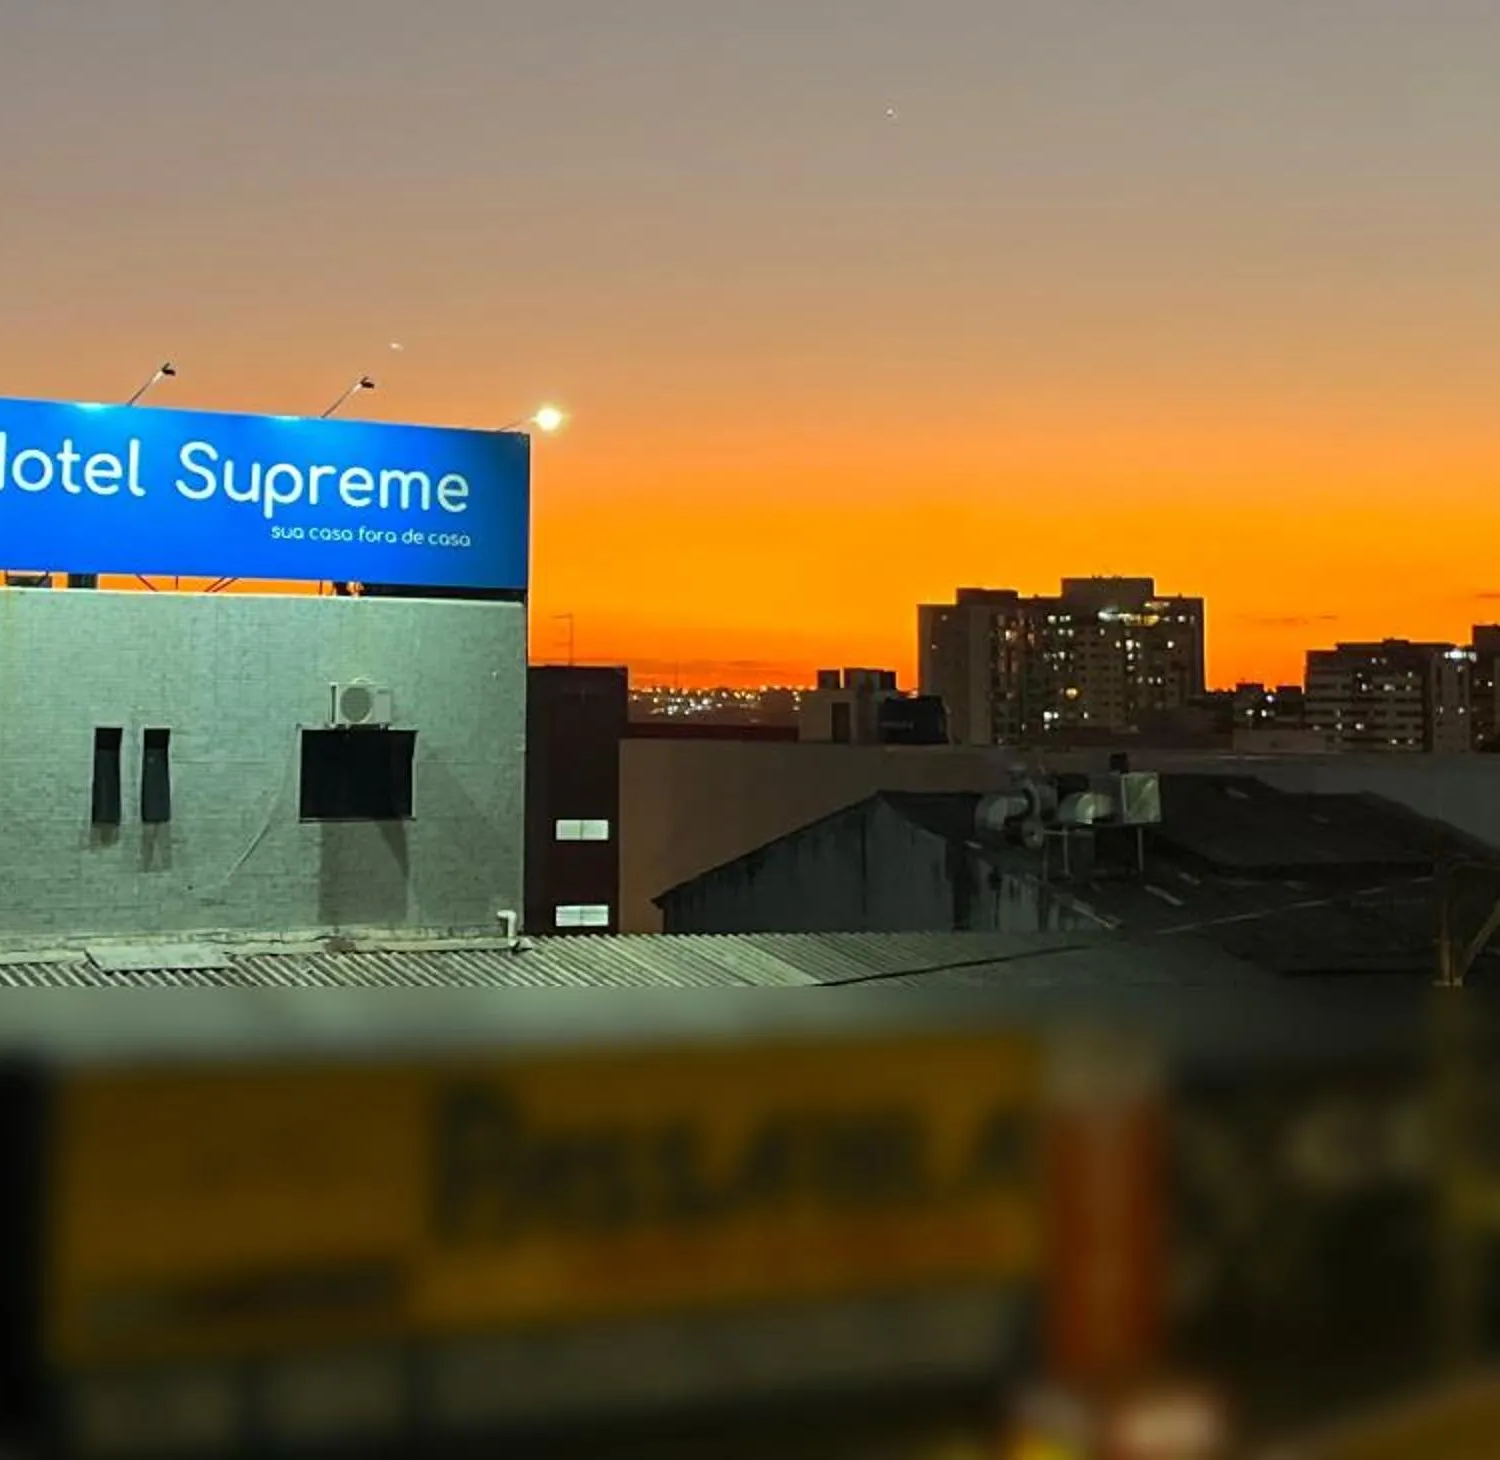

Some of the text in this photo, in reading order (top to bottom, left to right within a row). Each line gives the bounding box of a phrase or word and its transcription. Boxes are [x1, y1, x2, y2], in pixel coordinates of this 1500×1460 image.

[175, 441, 470, 519] Supreme
[271, 525, 472, 547] sua casa fora de casa
